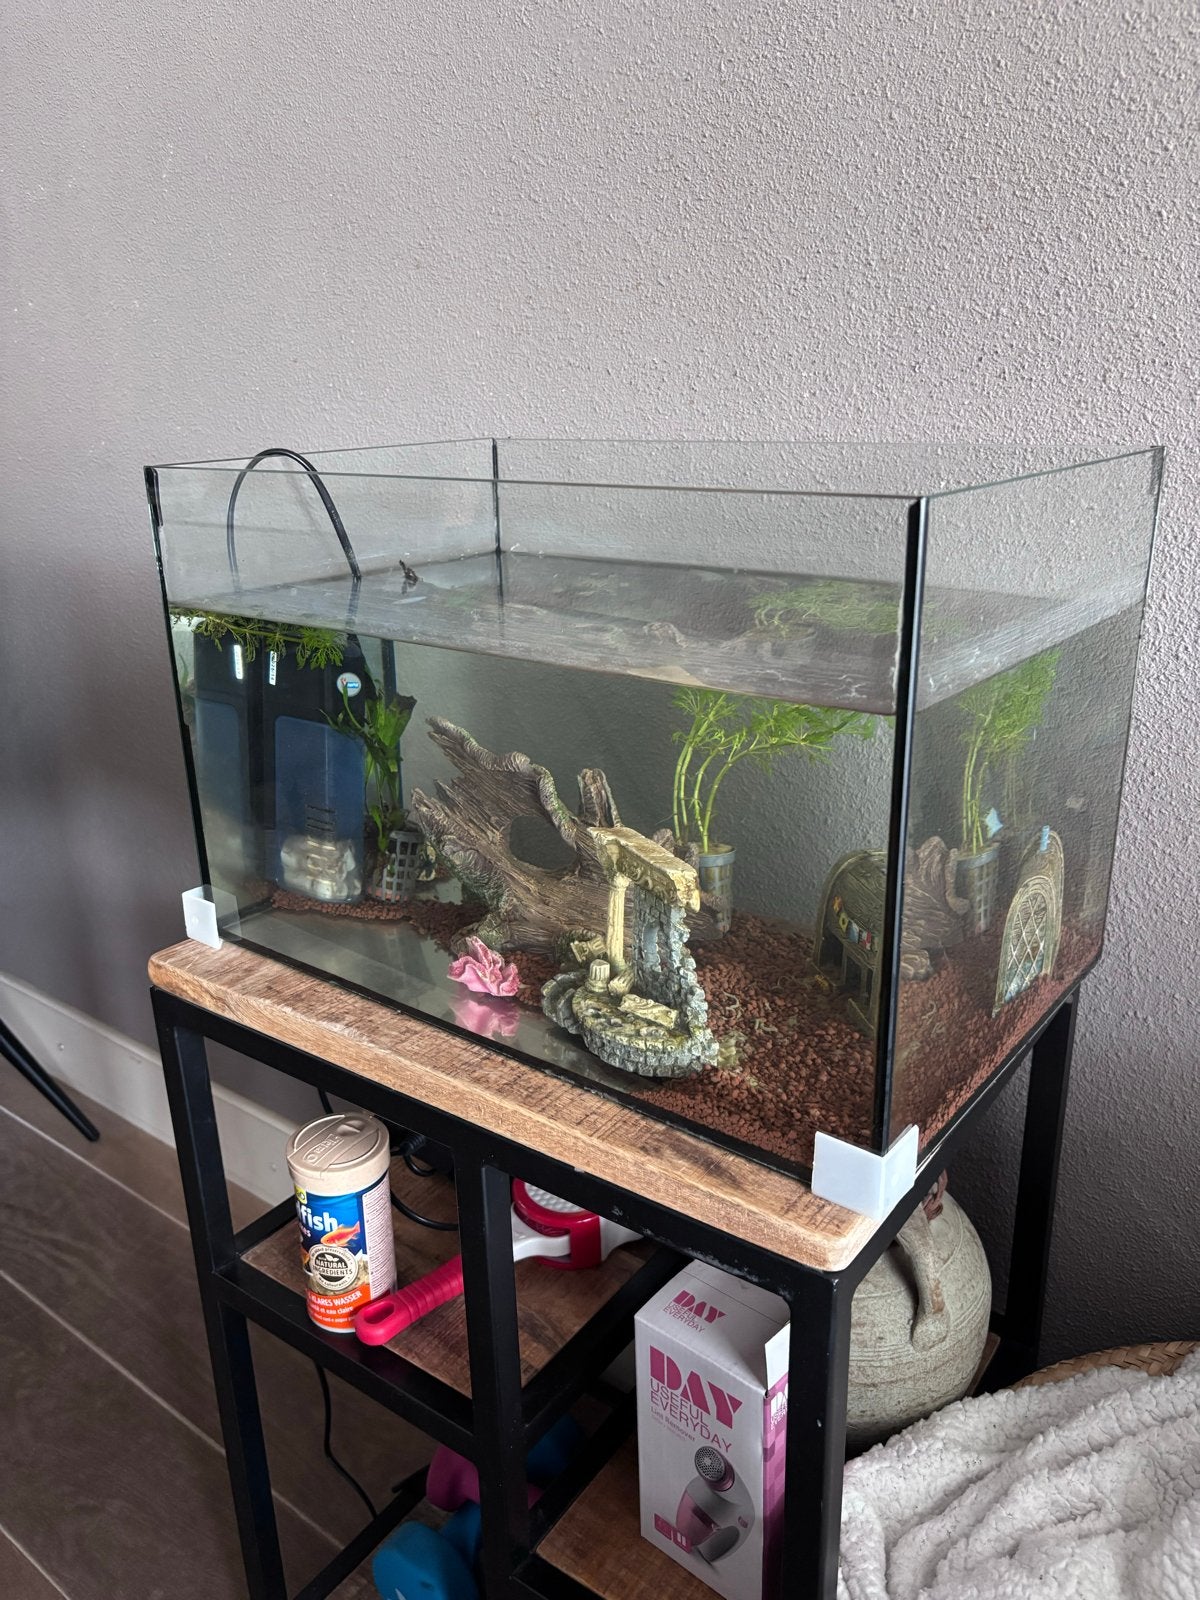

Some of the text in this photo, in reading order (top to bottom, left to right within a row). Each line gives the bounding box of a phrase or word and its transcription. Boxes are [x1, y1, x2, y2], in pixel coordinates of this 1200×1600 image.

[313, 1265, 353, 1275] INGREDIENTS
[315, 1259, 347, 1269] NATURAL
[333, 1290, 363, 1307] WASSER
[667, 1301, 697, 1321] USEFUL
[672, 1290, 726, 1323] DAY
[663, 1306, 705, 1332] EVERYDAY
[650, 1345, 742, 1429] DAY
[650, 1378, 708, 1427] USEFUL
[650, 1391, 732, 1453] EVERYDAY
